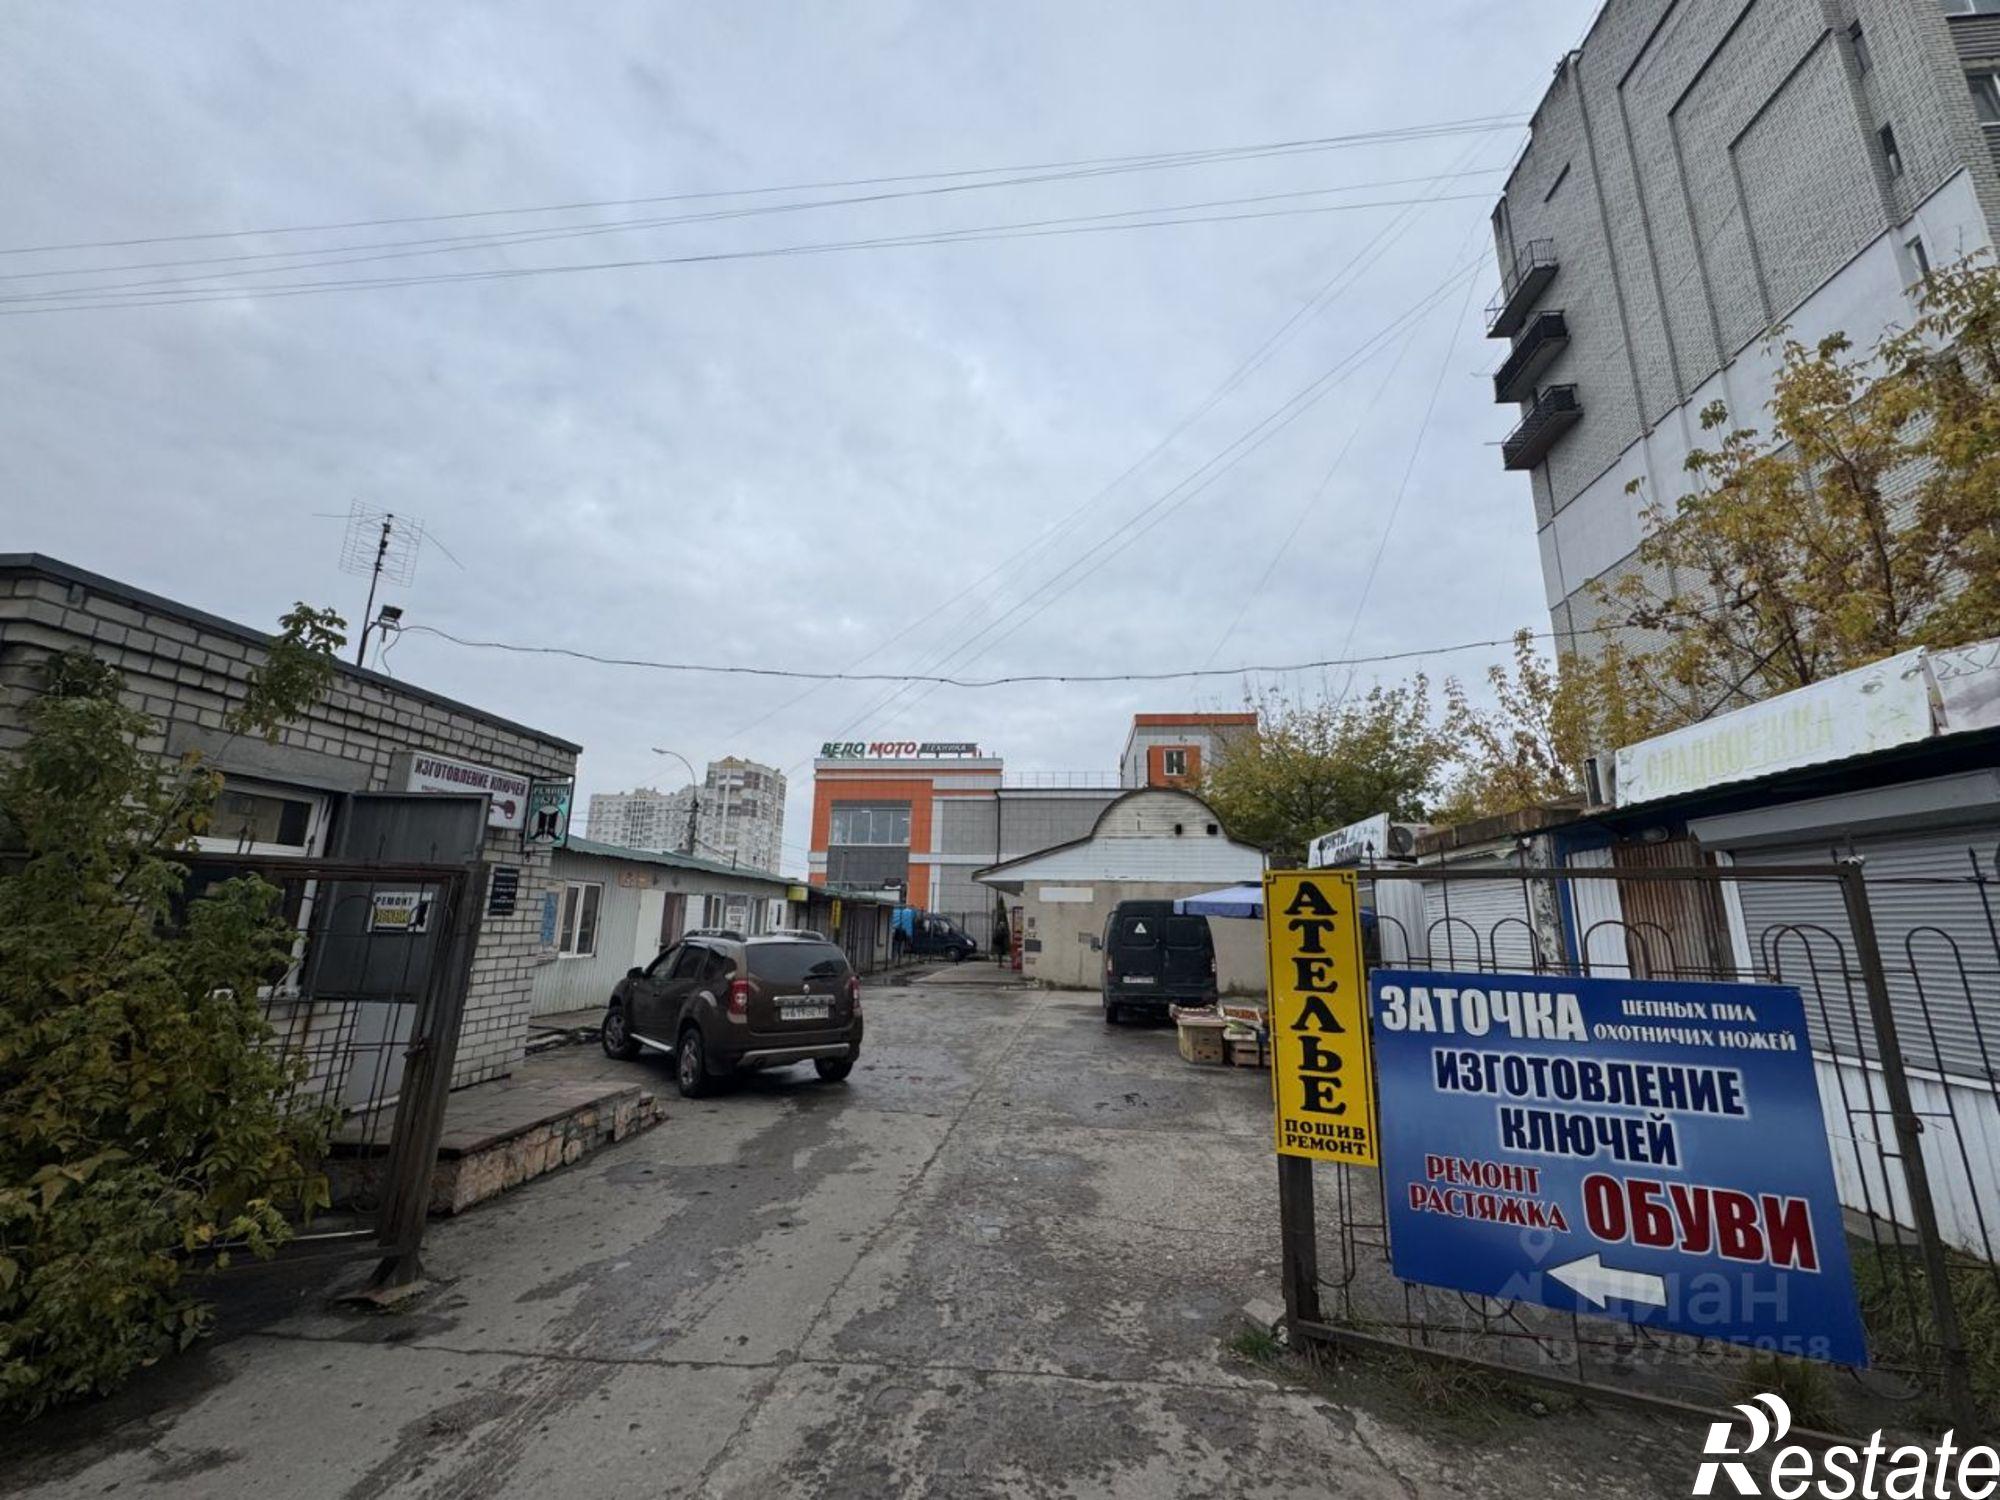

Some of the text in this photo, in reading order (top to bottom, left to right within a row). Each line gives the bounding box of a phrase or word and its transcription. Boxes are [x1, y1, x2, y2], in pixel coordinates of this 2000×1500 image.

[821, 742, 865, 755] ВЕЛО
[869, 742, 917, 755] МОТО
[415, 758, 489, 789] ИЗГОТОВЛЕНИЕ
[376, 896, 414, 906] РЕМОНТ
[1283, 880, 1346, 1115] АТЕЛЬЕ
[1381, 985, 1588, 1042] ЗАТОЧКА
[1622, 999, 1756, 1022] ЦЕПНЫХ ПИЛ
[1593, 1023, 1797, 1051] ОХОТНИЧИХ НОЖЕЙ
[1434, 1049, 1746, 1117] ИЗГОТОВЛЕНИЕ
[1285, 1119, 1366, 1141] ПОШИВ
[1286, 1133, 1367, 1156] РЕМОНТ
[1500, 1106, 1679, 1167] КЛЮЧЕЙ
[1426, 1153, 1541, 1196] РЕМОНТ
[1409, 1184, 1570, 1234] РАСТЯЖКА
[1582, 1174, 1821, 1274] ОБУВИ
